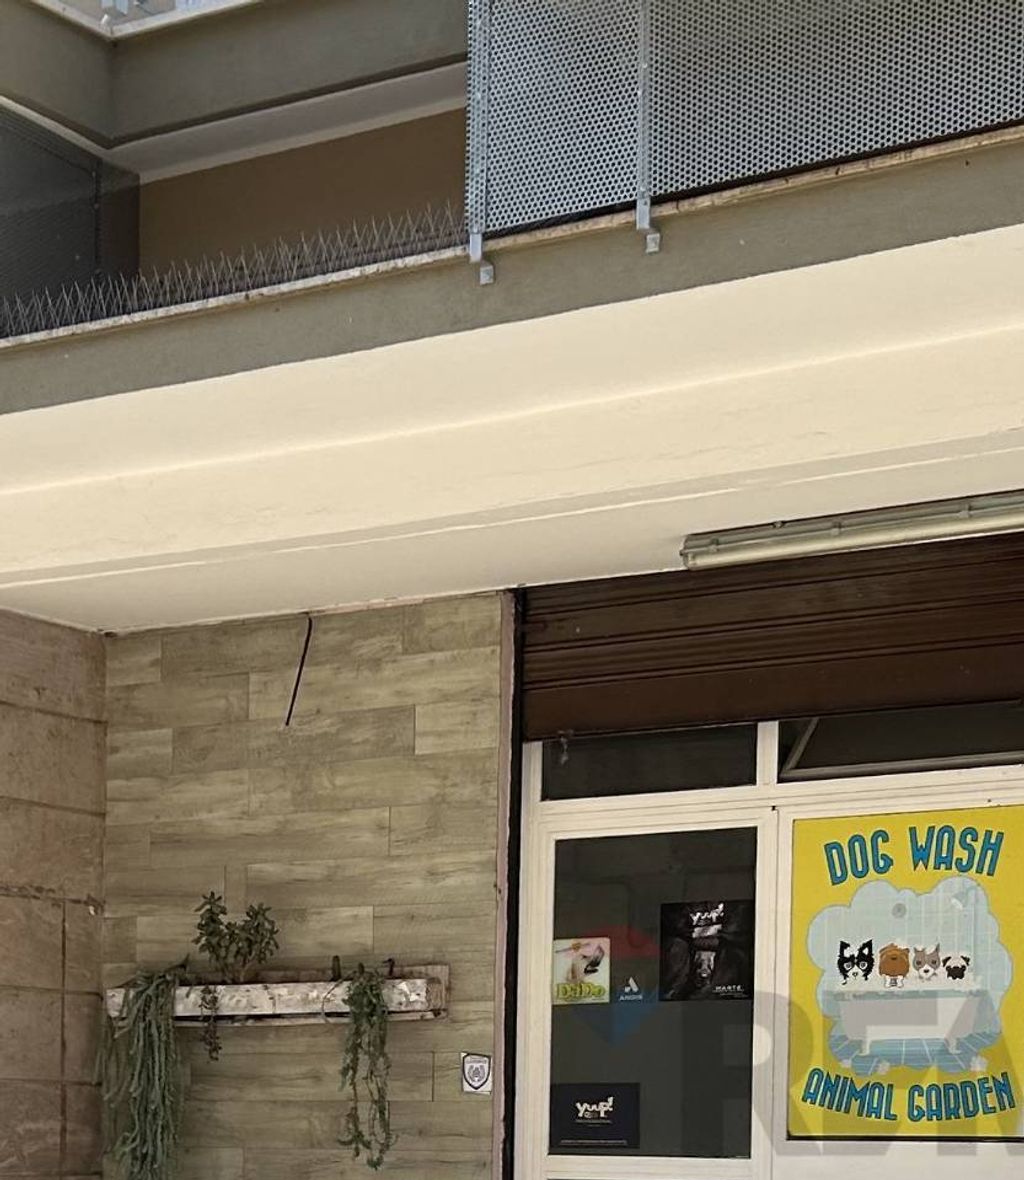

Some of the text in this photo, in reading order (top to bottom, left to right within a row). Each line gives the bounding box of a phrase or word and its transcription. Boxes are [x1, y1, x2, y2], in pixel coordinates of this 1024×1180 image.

[824, 825, 1005, 886] DOG WASH
[575, 1096, 614, 1117] yuup!
[801, 1067, 1016, 1122] ANIMAL GARDEN
